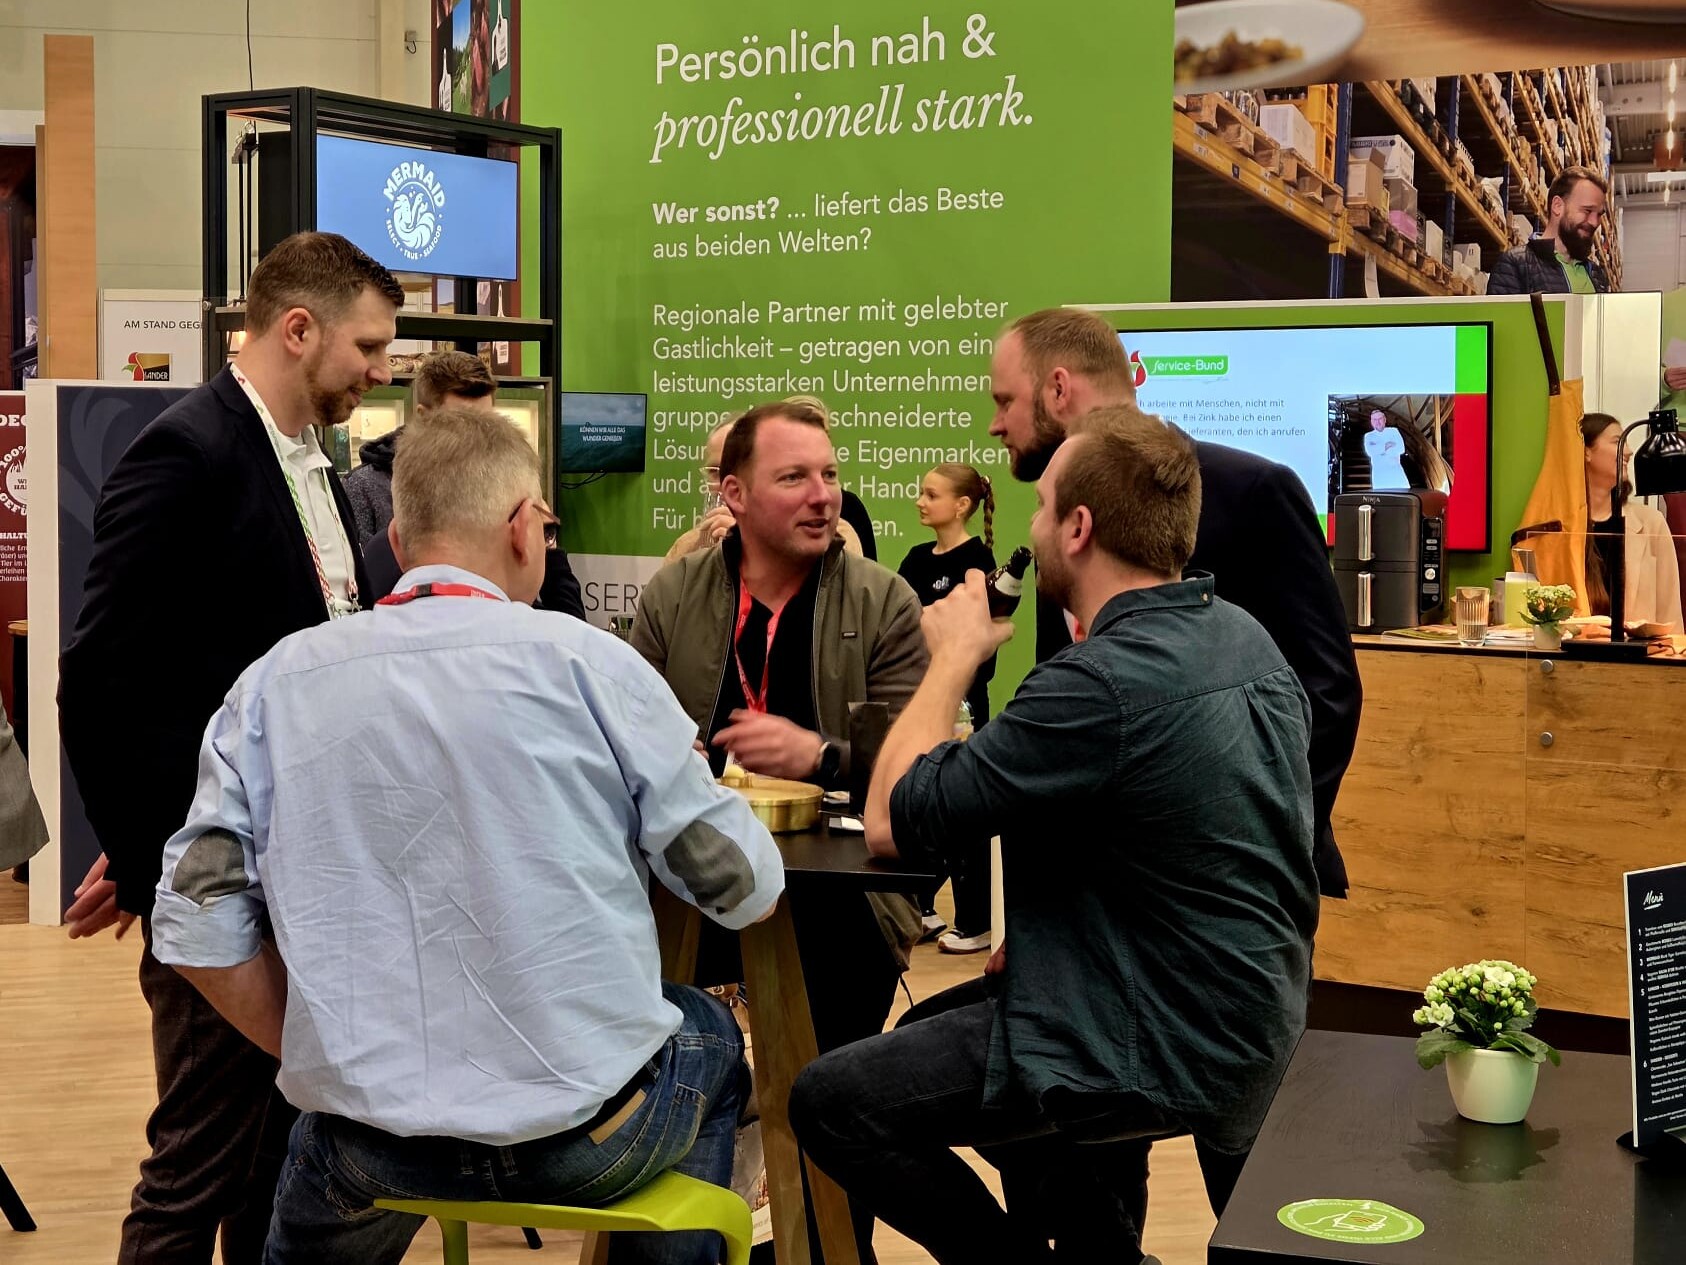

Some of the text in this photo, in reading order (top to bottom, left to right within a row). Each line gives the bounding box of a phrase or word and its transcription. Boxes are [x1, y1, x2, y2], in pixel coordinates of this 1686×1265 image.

[656, 13, 997, 84] Persönlich nah &
[649, 74, 1033, 163] professionell stark.
[383, 161, 445, 207] MERMAID
[652, 202, 699, 225] Wer
[705, 196, 780, 223] sonst?
[815, 191, 881, 217] liefert
[888, 188, 928, 214] das
[937, 187, 1004, 212] Beste
[386, 219, 442, 260] SELECT TRUE SEAFOOD
[653, 227, 872, 259] aus beiden Welten?
[124, 320, 202, 329] AM STAND GEG
[653, 294, 1008, 331] Regionale Partner mit gelebter
[653, 336, 774, 360] Gastlichkeit
[799, 337, 900, 363] getragen
[908, 339, 950, 357] von
[1153, 359, 1225, 374] Service-Bund
[653, 367, 992, 399] leistungsstarken Unternehmen
[1147, 400, 1177, 408] arbeite
[1179, 400, 1193, 408] mit
[1195, 400, 1243, 409] Menschen,
[1245, 400, 1267, 408] nicht
[1269, 400, 1285, 408] mit
[1183, 413, 1196, 422] Bei
[1198, 413, 1217, 422] Zink
[1218, 413, 1240, 421] habe
[1242, 413, 1255, 421] ich
[1257, 413, 1282, 421] einen
[1237, 427, 1255, 436] den
[1256, 427, 1269, 436] ich
[1271, 427, 1306, 436] anrufen
[858, 440, 1010, 469] Eigenmarken
[653, 472, 691, 494] und
[653, 508, 686, 530] Für
